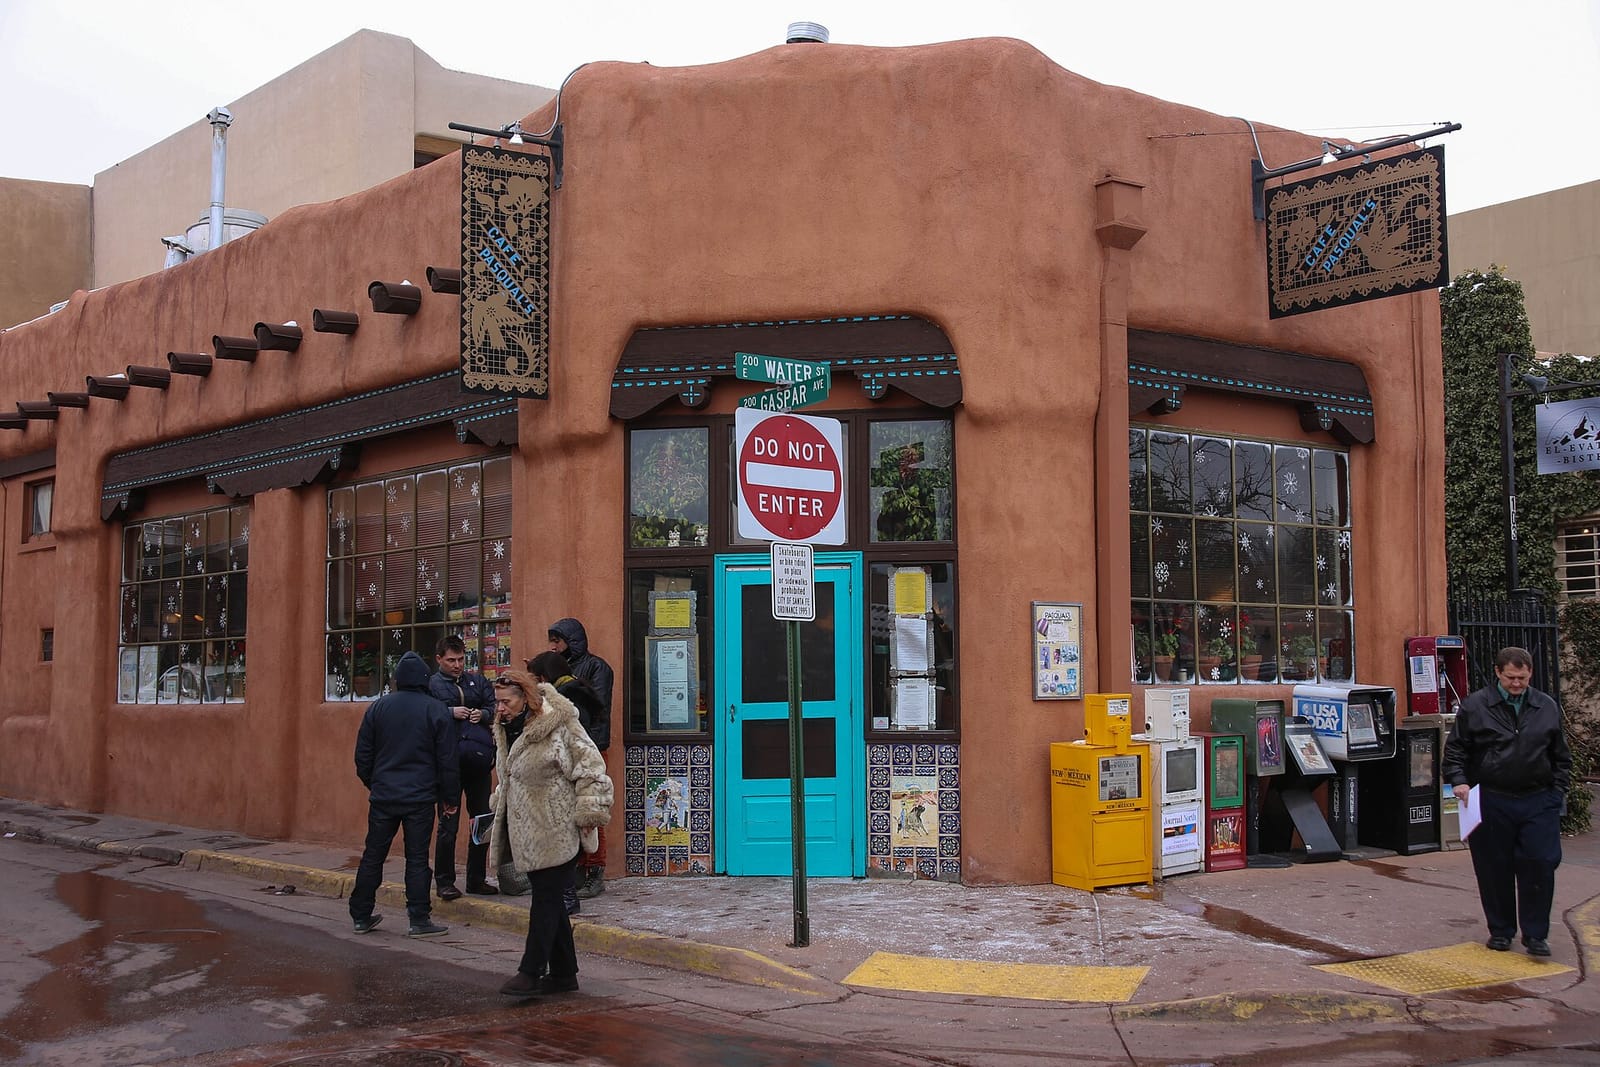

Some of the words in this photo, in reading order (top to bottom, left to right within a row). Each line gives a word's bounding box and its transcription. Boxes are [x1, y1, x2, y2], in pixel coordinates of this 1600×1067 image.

[1322, 199, 1377, 272] PASQUAL'S
[487, 227, 521, 266] CAFE
[1305, 224, 1336, 266] CAFE
[480, 247, 535, 314] PASQUAL'S
[742, 355, 759, 367] 200
[764, 360, 812, 382] WATER
[816, 366, 825, 376] ST
[742, 368, 748, 378] E
[743, 396, 757, 408] 200
[760, 384, 807, 412] GASPAR
[812, 379, 824, 392] AVE
[754, 436, 779, 457] DO
[788, 441, 826, 463] NOT
[758, 493, 823, 517] ENTER
[778, 547, 806, 557] Skateboards
[785, 558, 793, 566] bike
[794, 558, 806, 569] riding
[790, 567, 802, 576] plaza
[785, 577, 808, 585] sidewalks
[781, 586, 806, 595] prohibited
[777, 596, 785, 605] CITY
[786, 596, 792, 605] OF
[792, 597, 804, 605] SANTA
[777, 605, 798, 615] ORDINANCE
[1312, 703, 1339, 719] USA
[1307, 715, 1340, 730] ODAY
[1067, 771, 1092, 781] MEXICAN
[1163, 815, 1183, 825] Journal
[1184, 811, 1197, 821] North
[1411, 806, 1431, 820] THE
